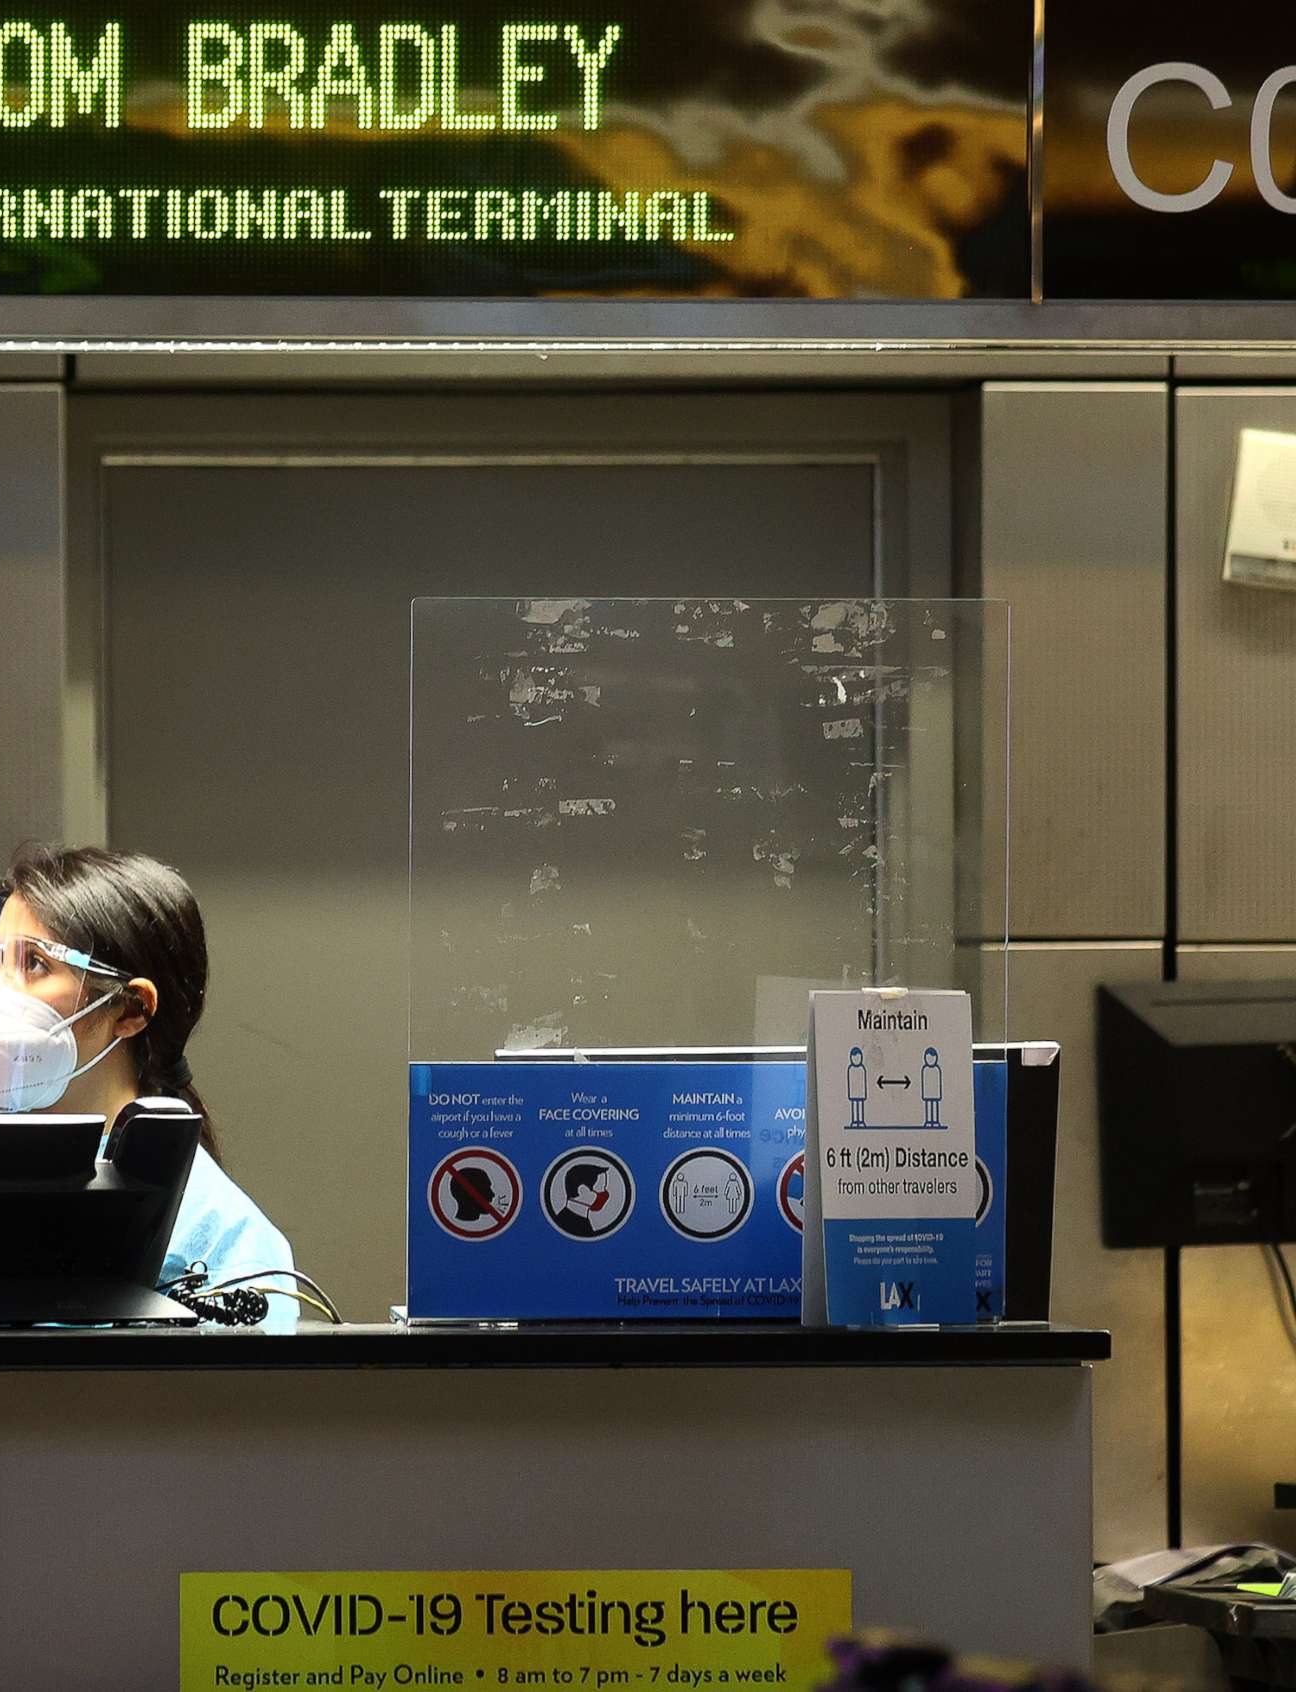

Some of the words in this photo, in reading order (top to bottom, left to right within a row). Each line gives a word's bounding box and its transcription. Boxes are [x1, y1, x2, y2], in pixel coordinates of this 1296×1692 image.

[186, 22, 622, 133] BRADLEY
[379, 189, 735, 243] TERMINAL
[857, 1008, 929, 1031] Maintain
[429, 1093, 451, 1106] DO
[452, 1093, 481, 1106] NOT
[482, 1095, 507, 1106] enter
[508, 1093, 524, 1106] the
[571, 1091, 597, 1104] Wear
[601, 1094, 608, 1104] a
[672, 1093, 735, 1105] MAINTAIN
[736, 1096, 743, 1105] a
[431, 1111, 462, 1125] airport
[471, 1113, 489, 1125] you
[490, 1111, 514, 1122] have
[515, 1113, 522, 1122] a
[539, 1108, 571, 1121] FACE
[572, 1108, 640, 1121] COVERING
[669, 1109, 714, 1122] minimum
[716, 1109, 745, 1122] 6-foot
[438, 1127, 468, 1141] cough
[470, 1129, 480, 1138] or
[490, 1127, 513, 1138] fever
[565, 1127, 574, 1138] at
[576, 1126, 587, 1138] all
[588, 1126, 614, 1138] times
[663, 1127, 702, 1139] distance
[703, 1128, 712, 1139] at
[714, 1126, 724, 1139] all
[725, 1126, 751, 1139] times
[826, 1147, 836, 1168] 6
[840, 1147, 852, 1168] ft
[856, 1146, 890, 1173] (2m)
[895, 1147, 969, 1168] Distance
[838, 1178, 865, 1195] from
[868, 1178, 900, 1195] other
[902, 1178, 957, 1195] travelers
[615, 1278, 679, 1293] TRAVEL
[681, 1278, 741, 1293] SAFELY
[743, 1278, 766, 1293] AT
[769, 1278, 802, 1293] LAX
[880, 1281, 914, 1310] LAX
[212, 1594, 462, 1637] COVID-19
[475, 1590, 666, 1647] Testing
[679, 1590, 799, 1635] here
[214, 1664, 299, 1690] Register
[305, 1664, 343, 1685] and
[350, 1666, 387, 1690] Pay
[393, 1664, 464, 1685] Online
[497, 1666, 508, 1685] 8
[514, 1670, 546, 1685] am
[552, 1668, 573, 1685] to
[579, 1667, 590, 1684] 7
[596, 1670, 629, 1689] pm
[649, 1667, 660, 1684] 7
[666, 1664, 712, 1688] days
[717, 1670, 729, 1684] a
[735, 1664, 787, 1684] week
